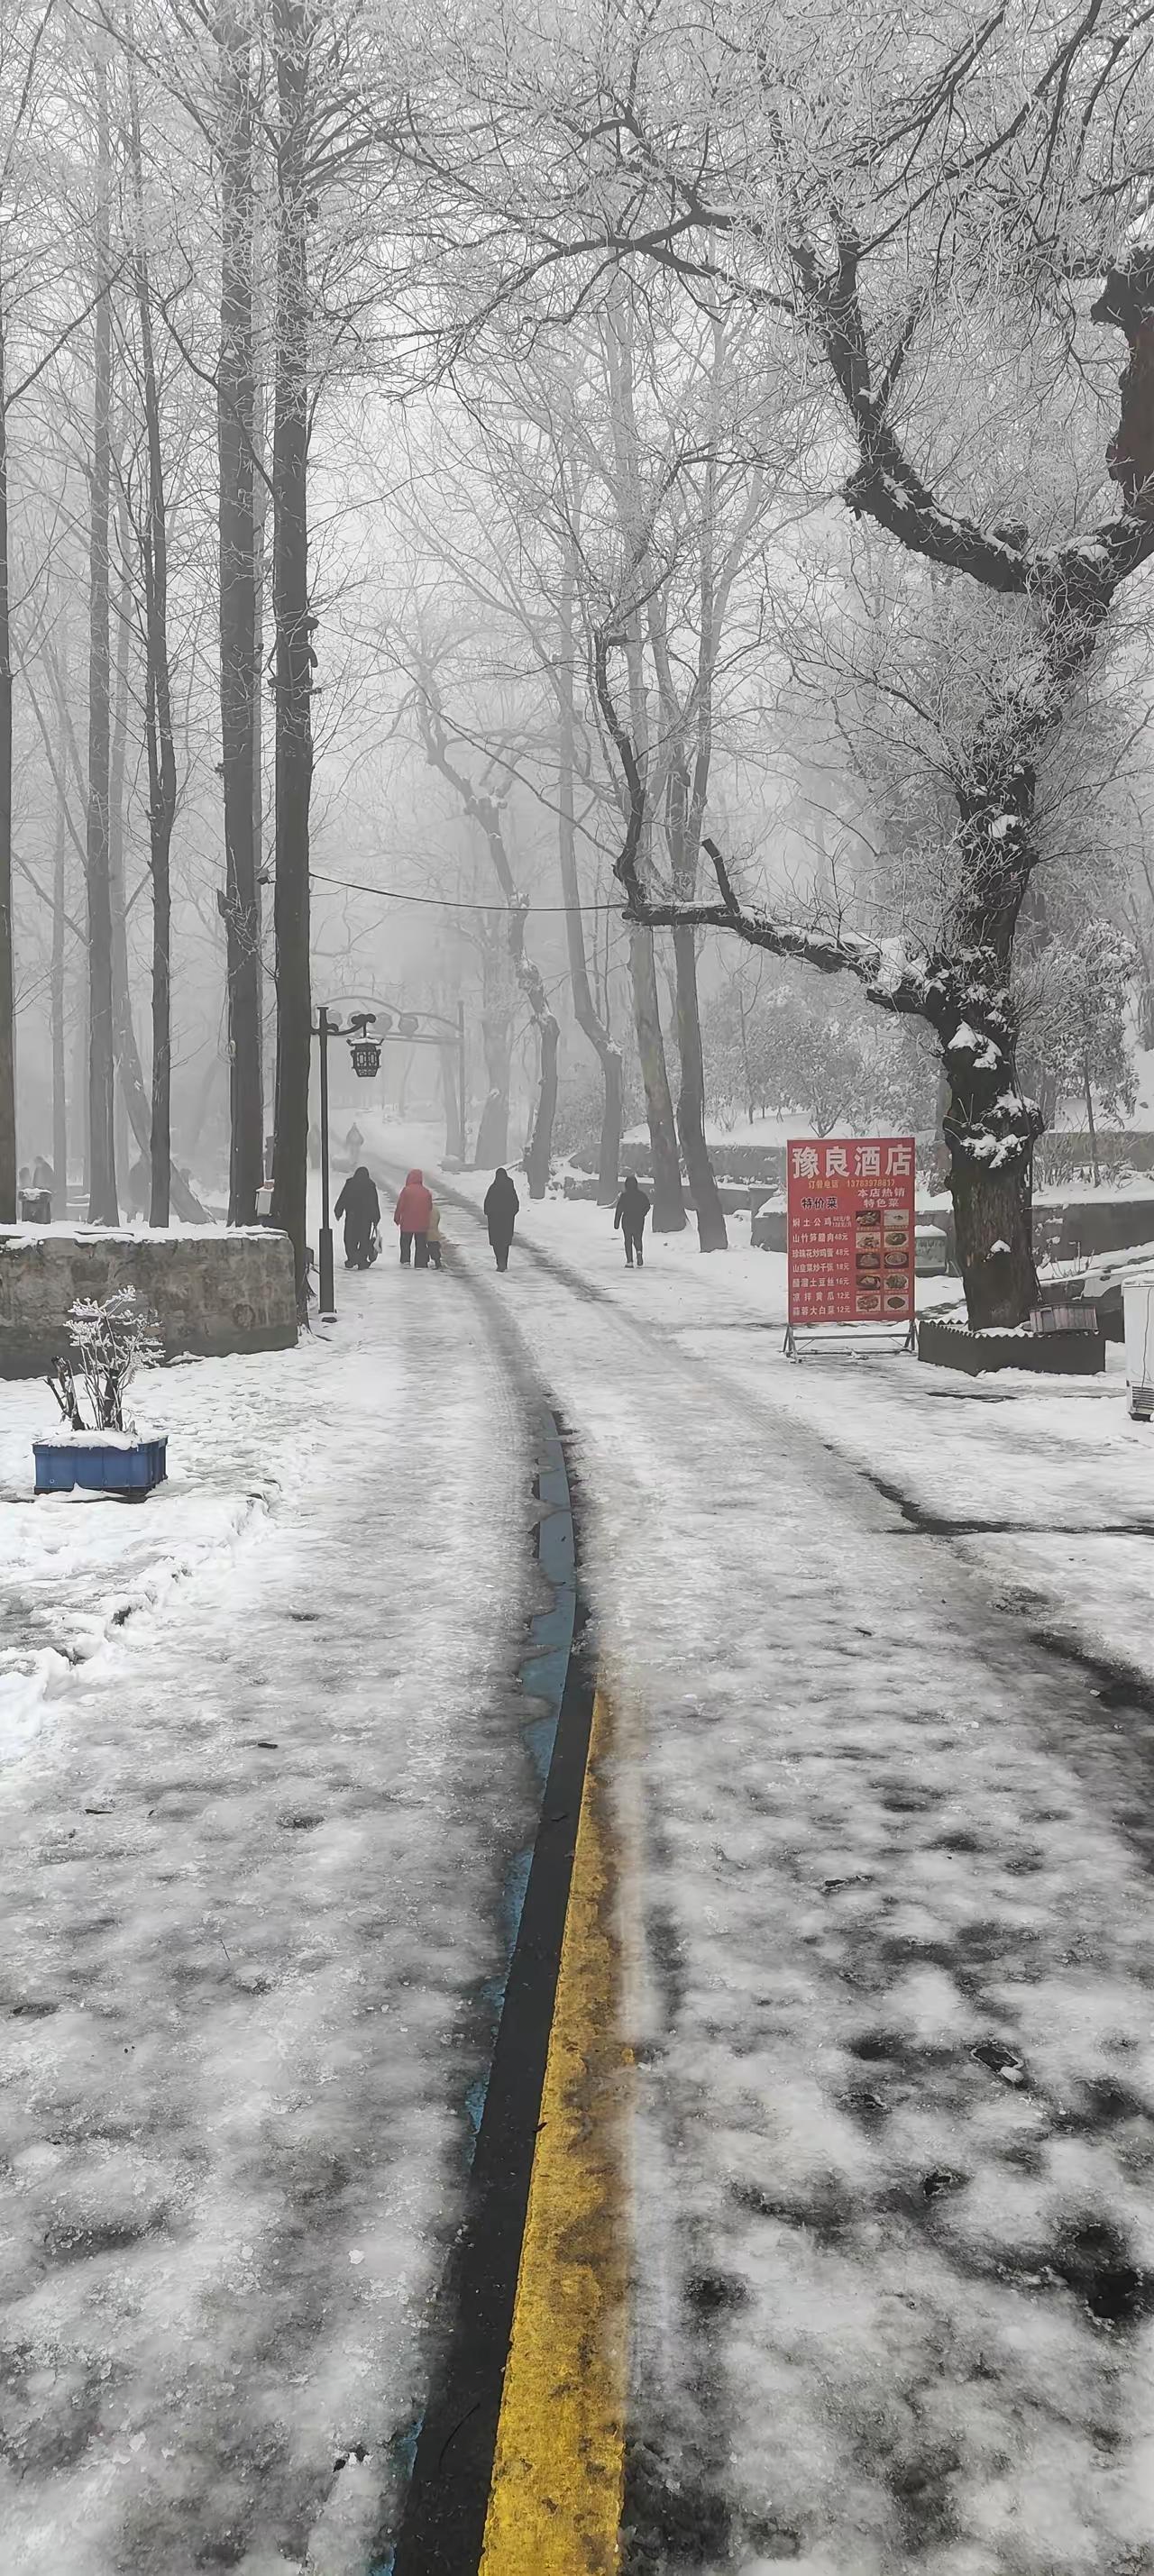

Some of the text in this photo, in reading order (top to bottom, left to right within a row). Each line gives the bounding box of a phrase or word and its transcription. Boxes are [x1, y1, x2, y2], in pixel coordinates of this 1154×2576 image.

[792, 1144, 912, 1179] 豫良酒店
[857, 1187, 906, 1198] 本店热销
[801, 1196, 838, 1210] 特价菜
[863, 1198, 900, 1209] 特色菜
